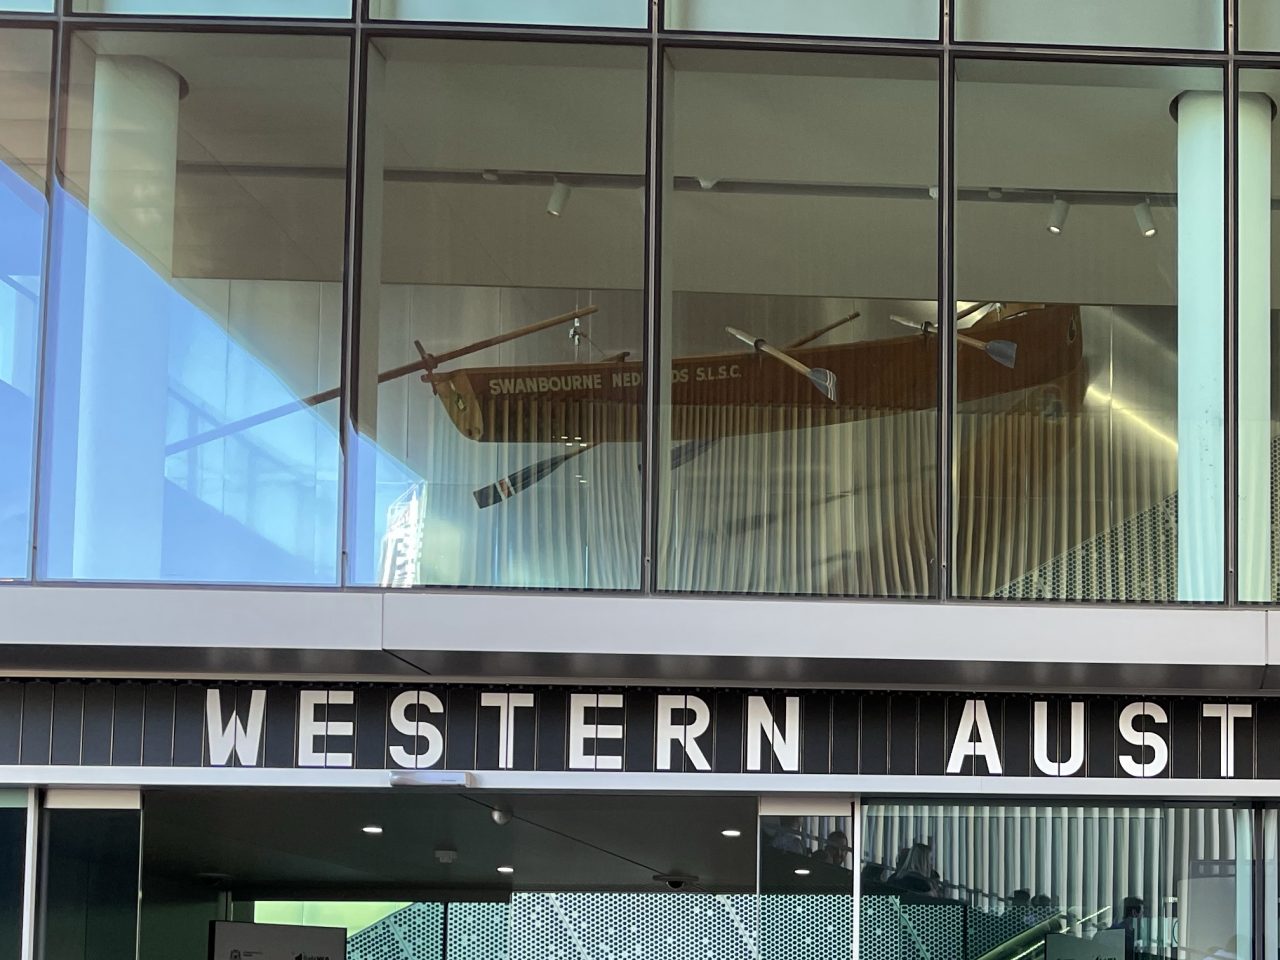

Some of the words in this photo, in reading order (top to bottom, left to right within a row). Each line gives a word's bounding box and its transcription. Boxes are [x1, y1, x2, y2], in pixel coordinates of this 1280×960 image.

[488, 374, 602, 396] SWANBOURNE
[612, 368, 689, 389] NEDDS
[696, 365, 742, 382] S.L.S.C.
[206, 688, 800, 771] WESTERN
